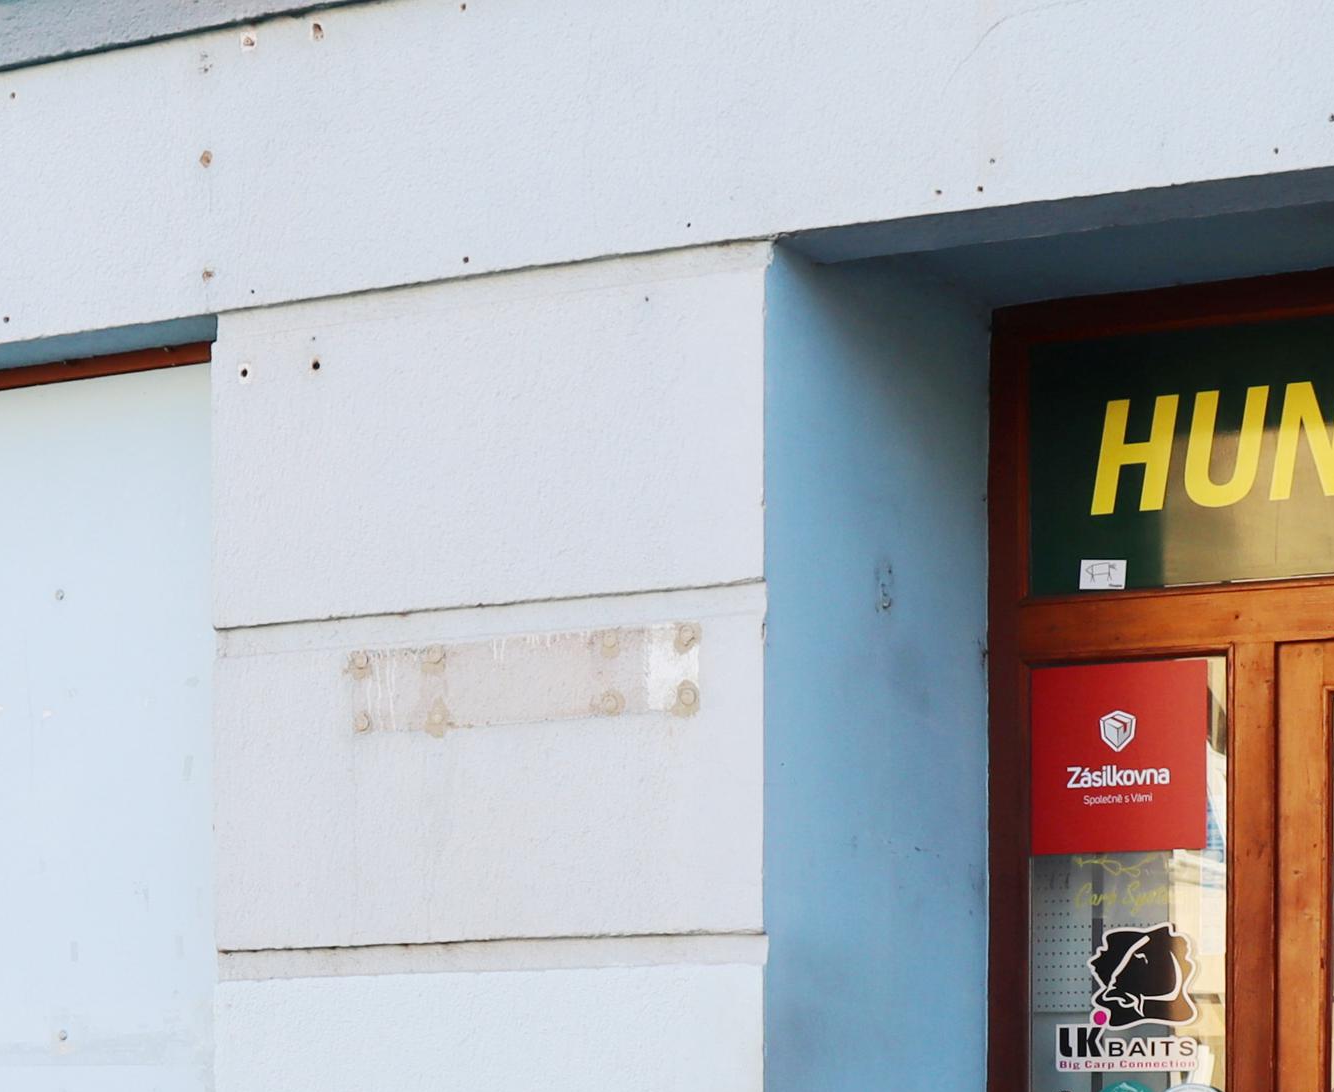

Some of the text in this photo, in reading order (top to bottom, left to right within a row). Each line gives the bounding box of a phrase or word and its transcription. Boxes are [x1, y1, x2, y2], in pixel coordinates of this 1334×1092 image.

[1067, 765, 1170, 788] Zásilkovna
[1083, 792, 1153, 806] Společně s Vámi
[1059, 1060, 1195, 1070] Big Carp Connection
